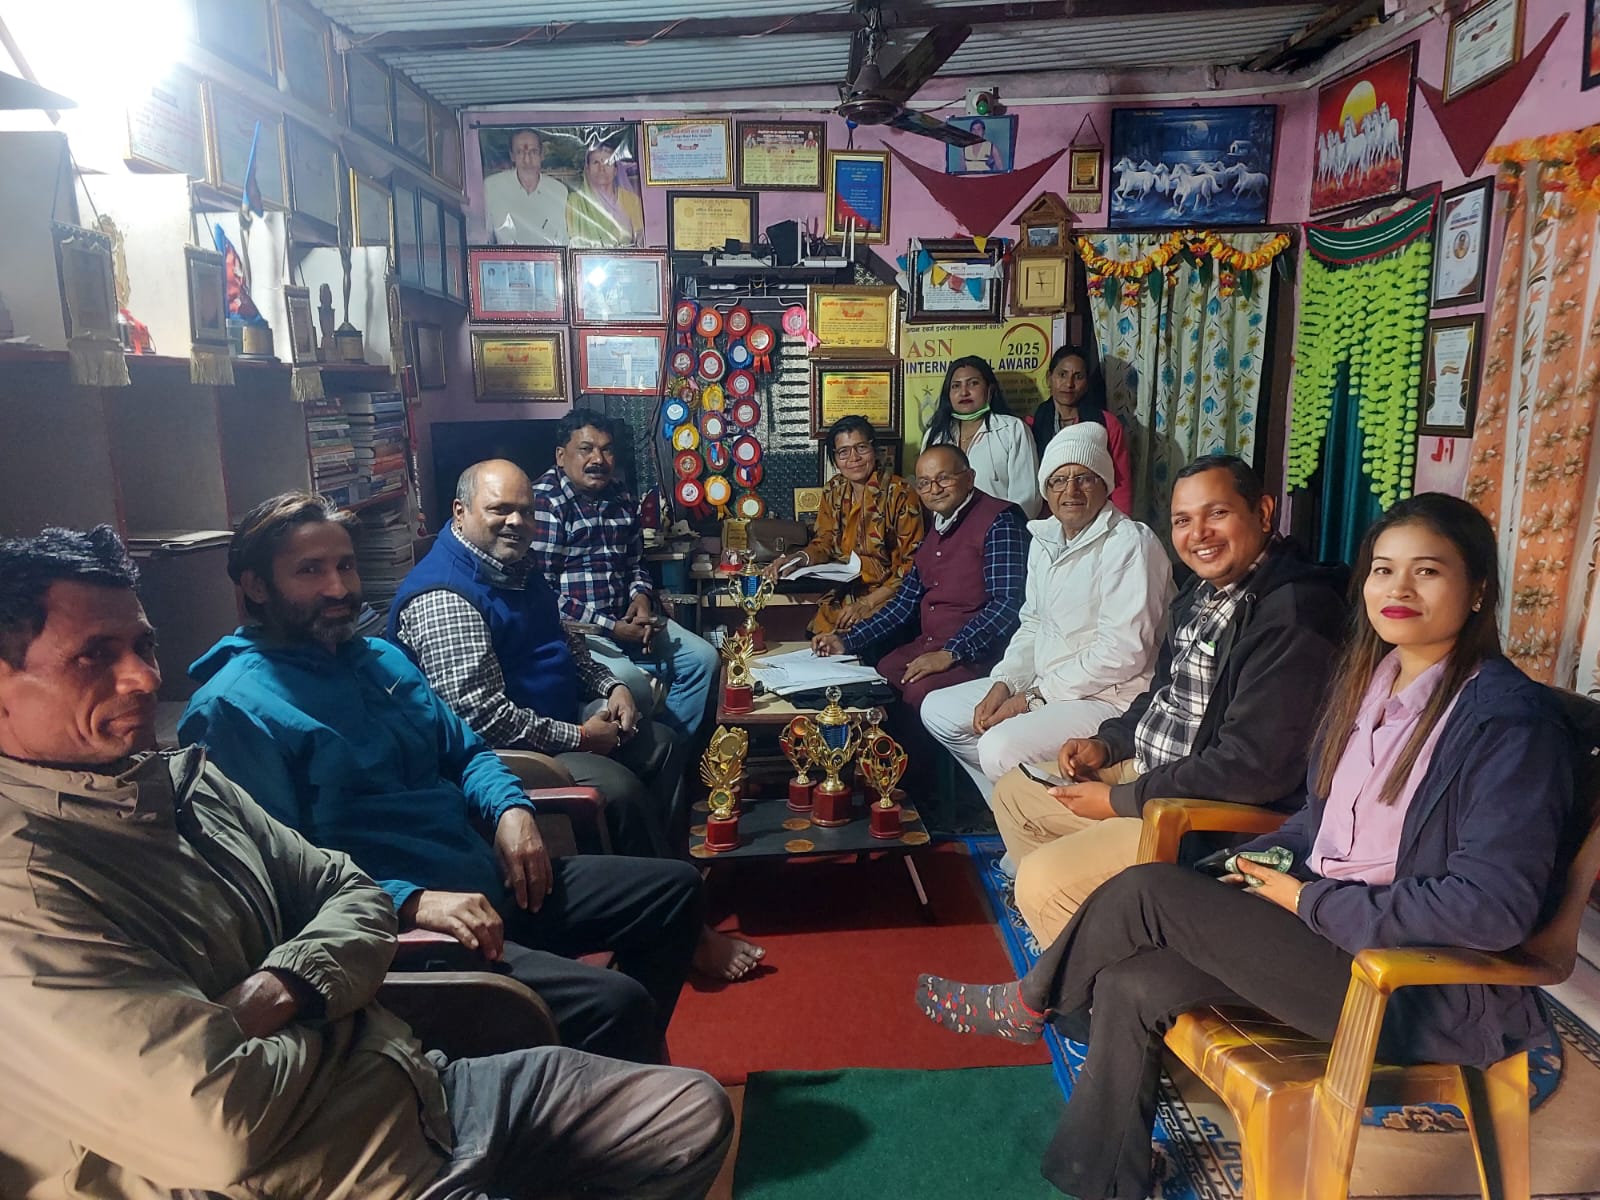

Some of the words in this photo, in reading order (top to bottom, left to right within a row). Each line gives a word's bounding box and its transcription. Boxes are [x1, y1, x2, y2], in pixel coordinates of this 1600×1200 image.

[907, 338, 953, 359] ASN
[1007, 342, 1040, 356] 2025
[906, 360, 995, 374] INTERNL
[998, 357, 1039, 370] AWARD
